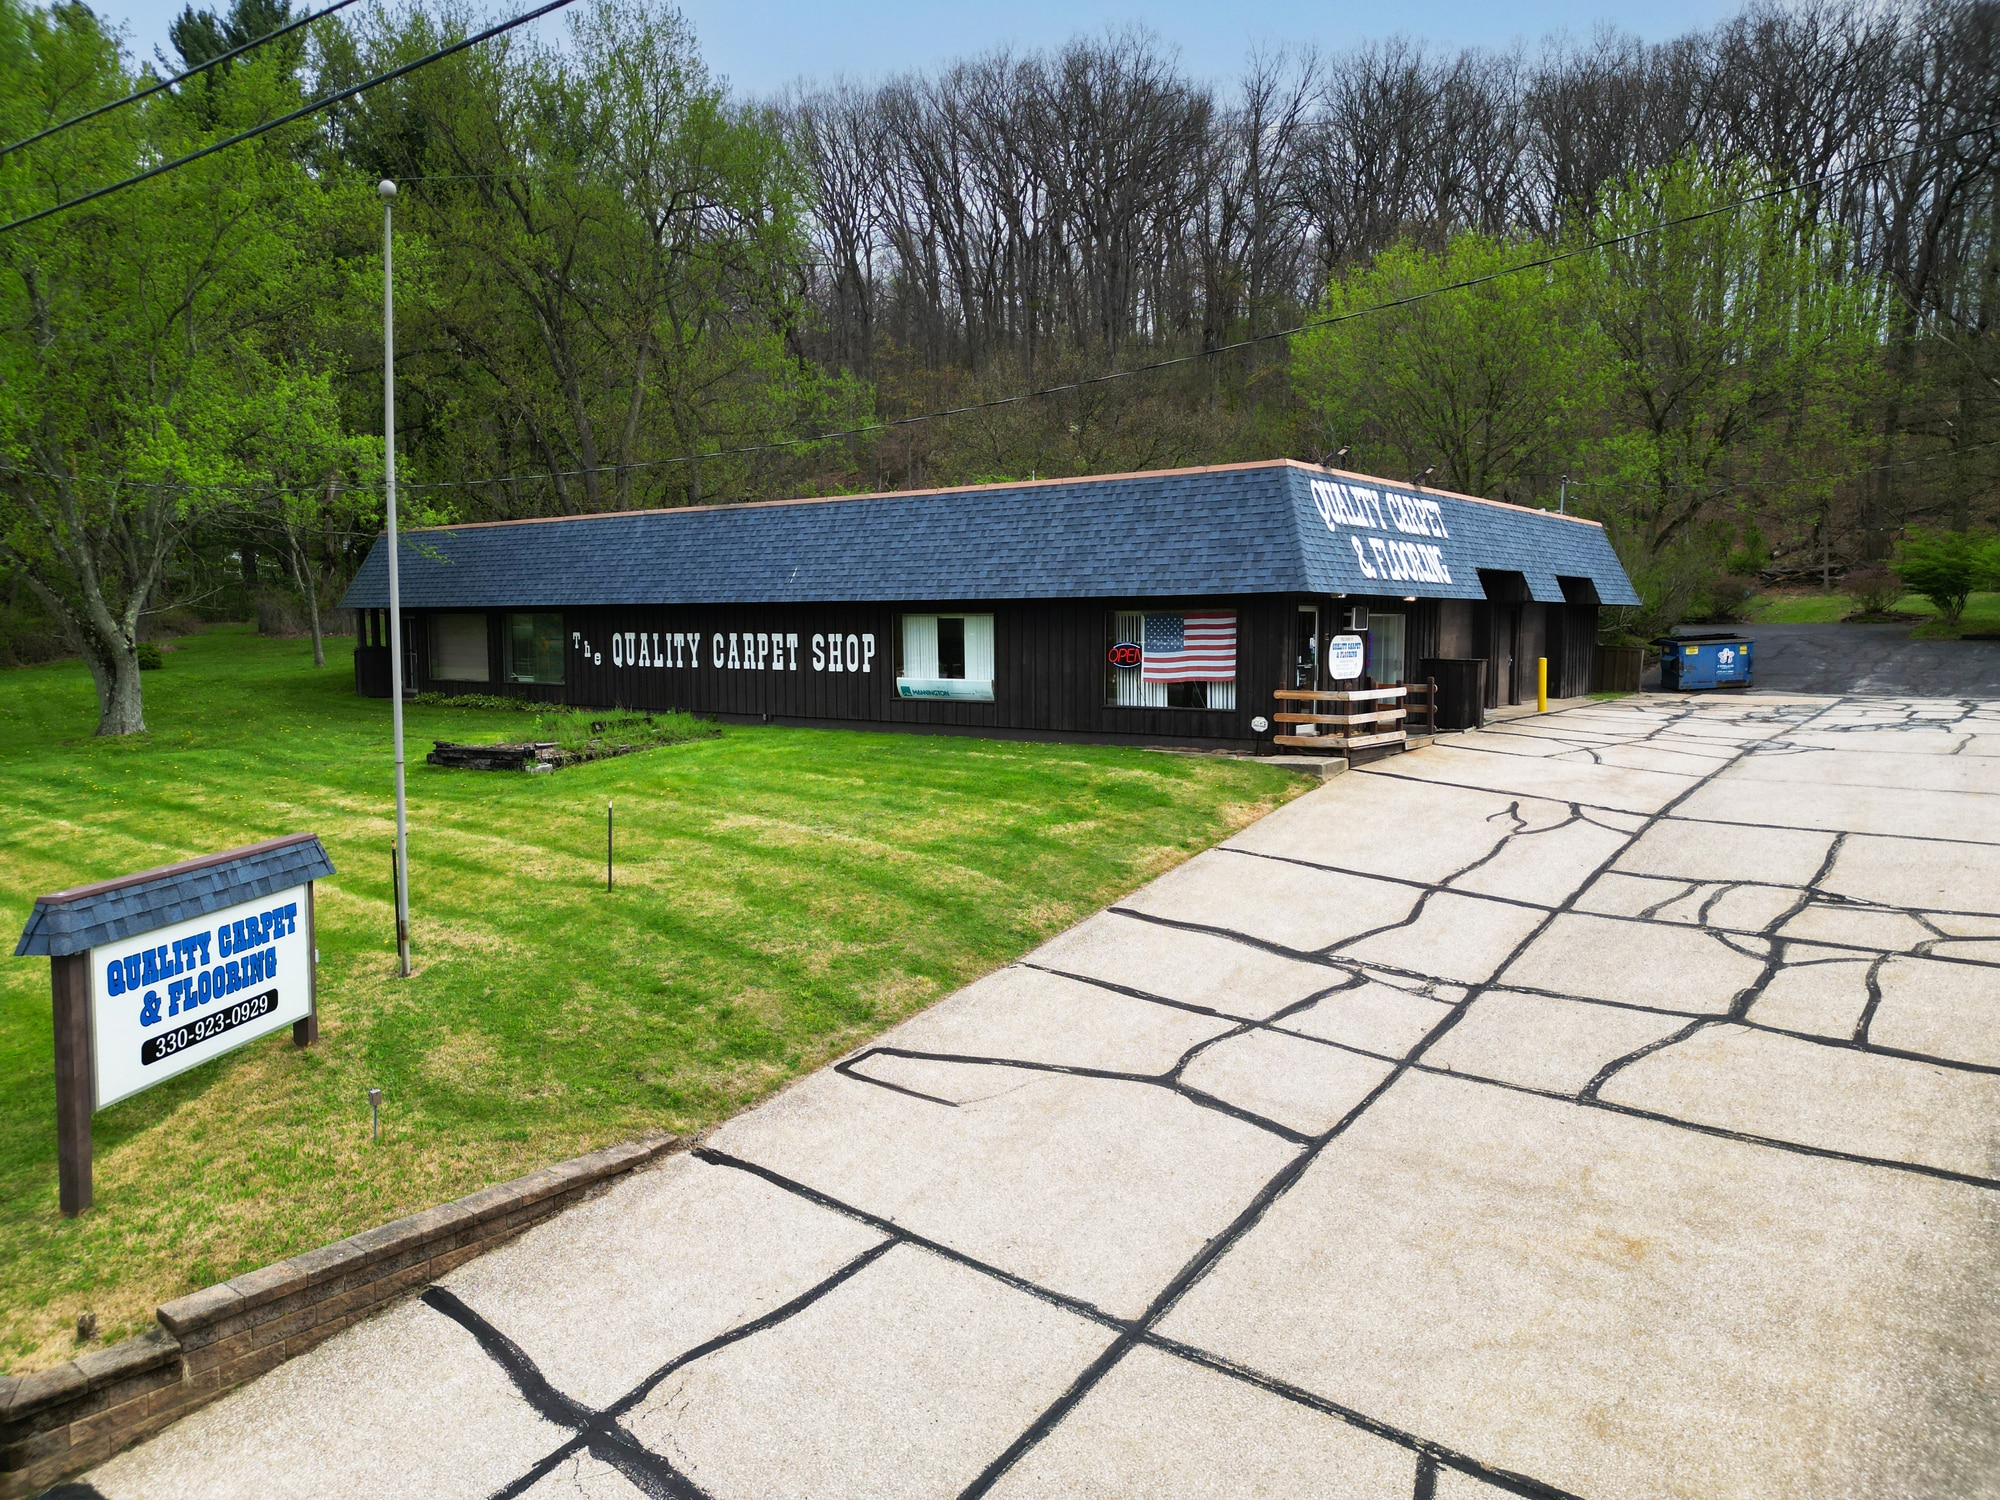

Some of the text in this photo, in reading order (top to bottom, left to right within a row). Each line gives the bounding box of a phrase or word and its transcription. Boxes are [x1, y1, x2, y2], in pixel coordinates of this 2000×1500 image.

[1310, 479, 1449, 539] QUALITY CARPET
[1351, 535, 1453, 584] & FLOORING
[572, 631, 875, 673] The QUALITY CARPET SHOP
[107, 902, 297, 997] QUALITY CARPET
[140, 946, 277, 1027] & FLOORING
[155, 995, 268, 1058] 330-923-0929
